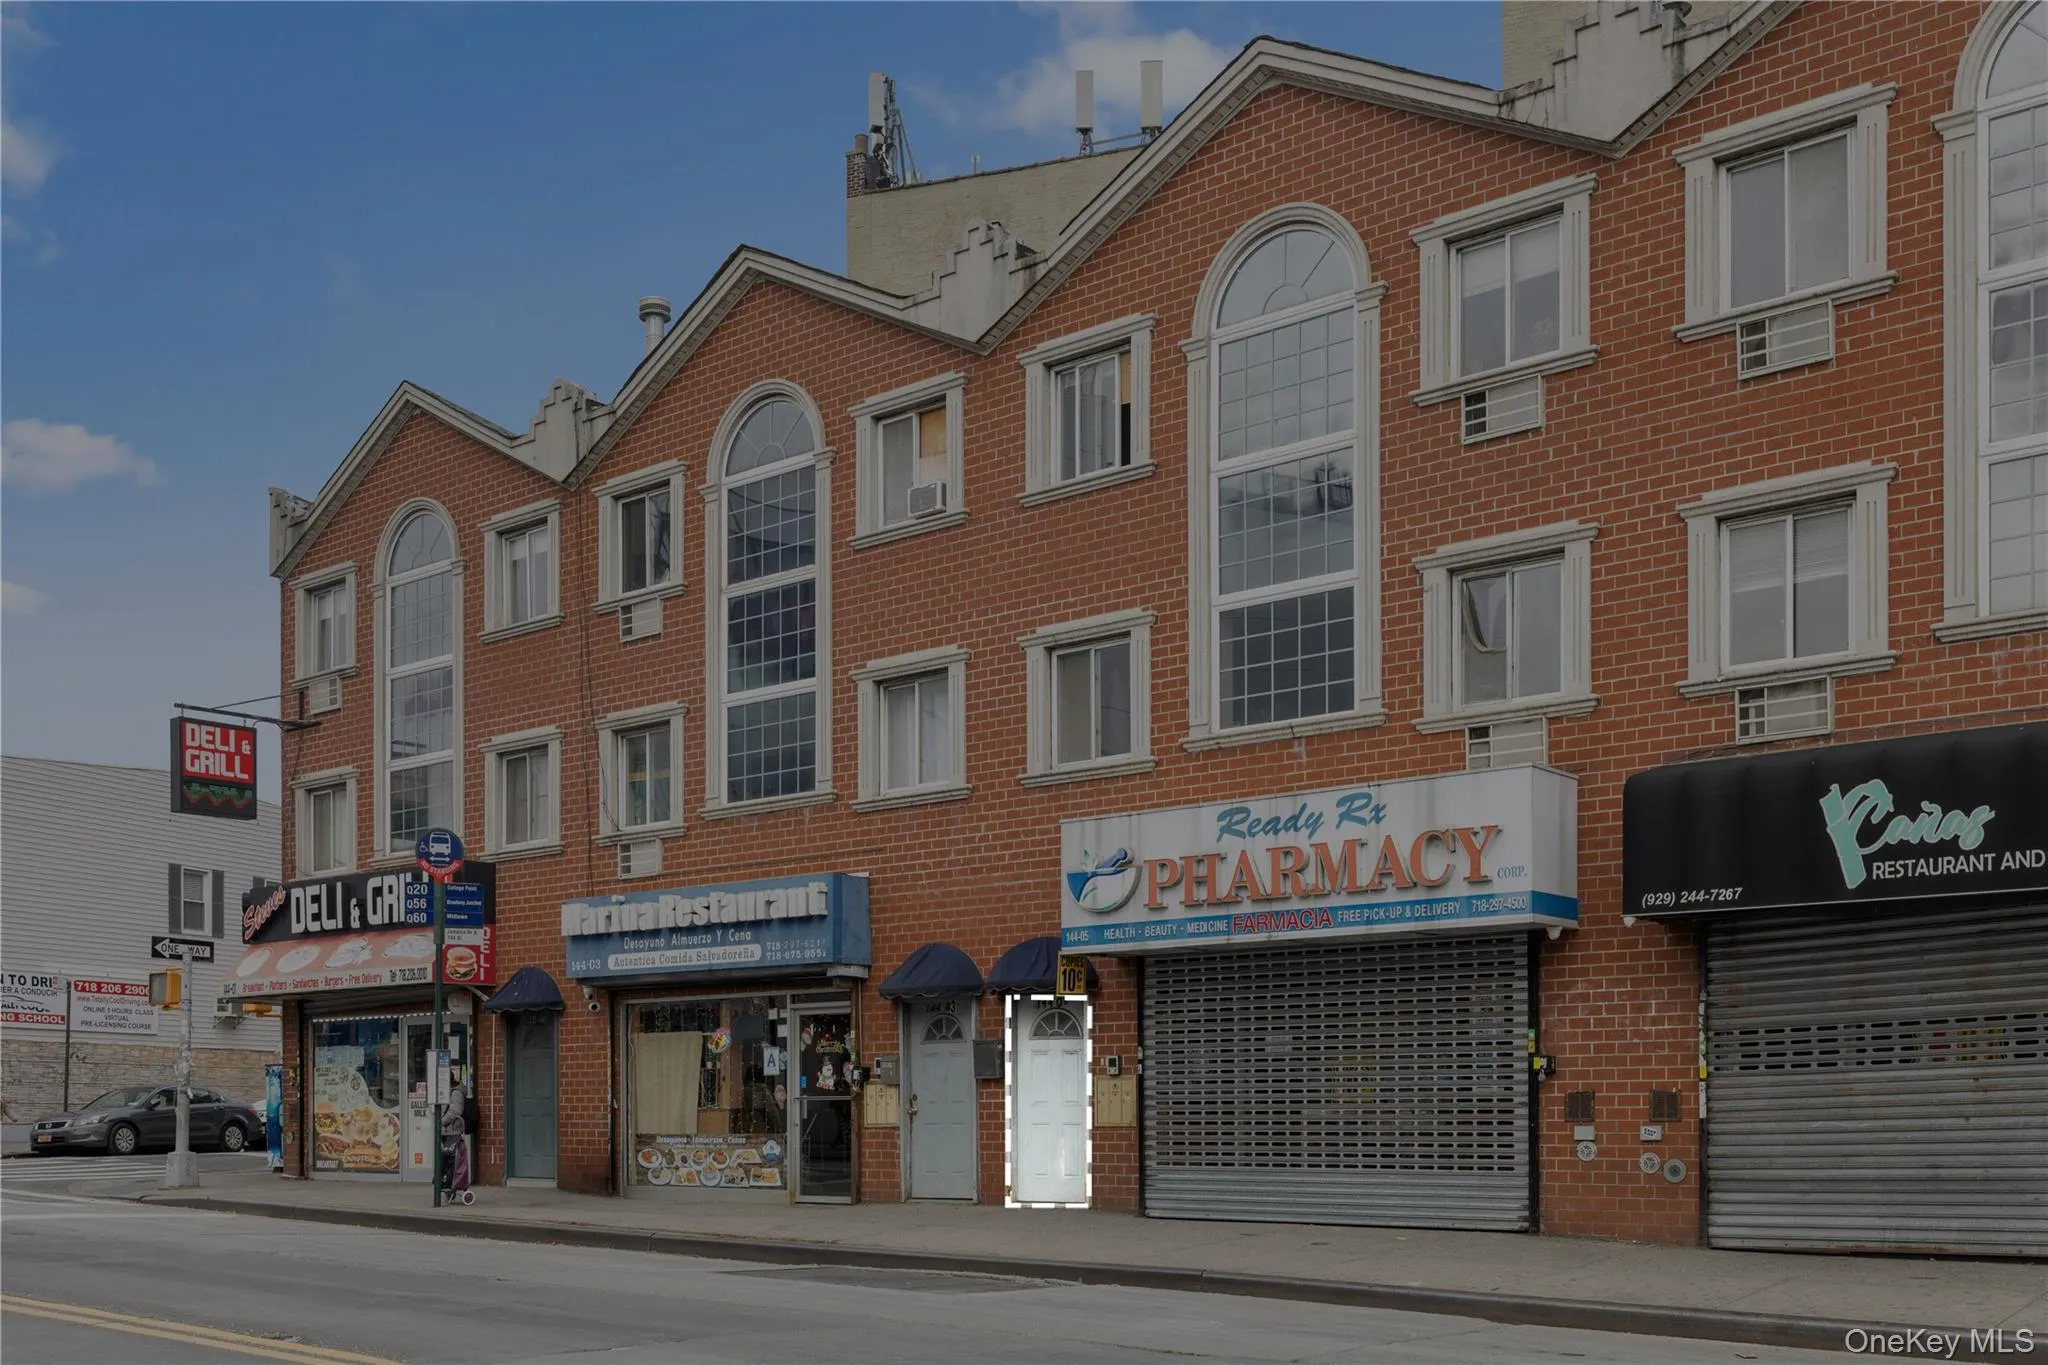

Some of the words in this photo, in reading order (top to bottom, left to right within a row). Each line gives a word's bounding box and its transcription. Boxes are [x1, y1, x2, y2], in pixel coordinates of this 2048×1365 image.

[185, 722, 235, 752] DELI
[242, 740, 251, 755] &
[185, 749, 249, 779] GRILL
[1217, 803, 1325, 844] Ready
[1335, 791, 1387, 829] Rx
[1143, 825, 1503, 910] PHARMACY
[1872, 853, 1995, 879] RESTAURANT
[2000, 849, 2046, 870] AND
[1497, 867, 1527, 879] CORP.
[406, 884, 428, 895] Q20
[290, 881, 343, 934] DELI
[350, 898, 360, 929] &
[366, 871, 428, 925] GRI
[406, 898, 427, 909] Q56
[1642, 890, 1676, 908] (929)
[1680, 887, 1743, 904] 244-7267
[560, 894, 658, 936] Marina
[658, 881, 828, 927] Restaurant
[406, 912, 427, 923] Q60
[1066, 930, 1089, 942] 144-05
[1104, 927, 1136, 940] HEALTH
[1145, 923, 1177, 937] BEAUTY
[1187, 919, 1228, 933] MEDICINE
[1232, 907, 1334, 935] FARMACIA
[1338, 910, 1361, 923] FREE
[1363, 906, 1402, 920] PICK-UP
[1404, 907, 1411, 917] &
[1414, 901, 1460, 917] DELIVERY
[1471, 896, 1527, 911] 718-297-4500
[624, 937, 664, 951] Desayuno
[671, 933, 712, 946] Almuerzo
[716, 930, 721, 942] Y
[729, 929, 751, 941] Cena
[161, 943, 179, 954] ONE
[187, 945, 206, 956] WAY
[480, 926, 492, 980] DELI
[571, 959, 600, 971] 144-03
[614, 954, 656, 969] Autentica
[659, 952, 694, 966] Comida
[696, 947, 755, 964] Salvadoreña
[1060, 955, 1085, 968] COPIES
[8, 974, 26, 986] TO
[31, 976, 52, 988] DRI
[76, 981, 98, 991] 718
[100, 983, 121, 993] 206
[324, 976, 344, 987] Burgers
[349, 975, 361, 985] Free
[362, 973, 382, 985] Delivery
[19, 1013, 65, 1024] SCHOOL
[81, 1020, 126, 1029] PRE-LICENSING
[767, 1053, 776, 1067] A
